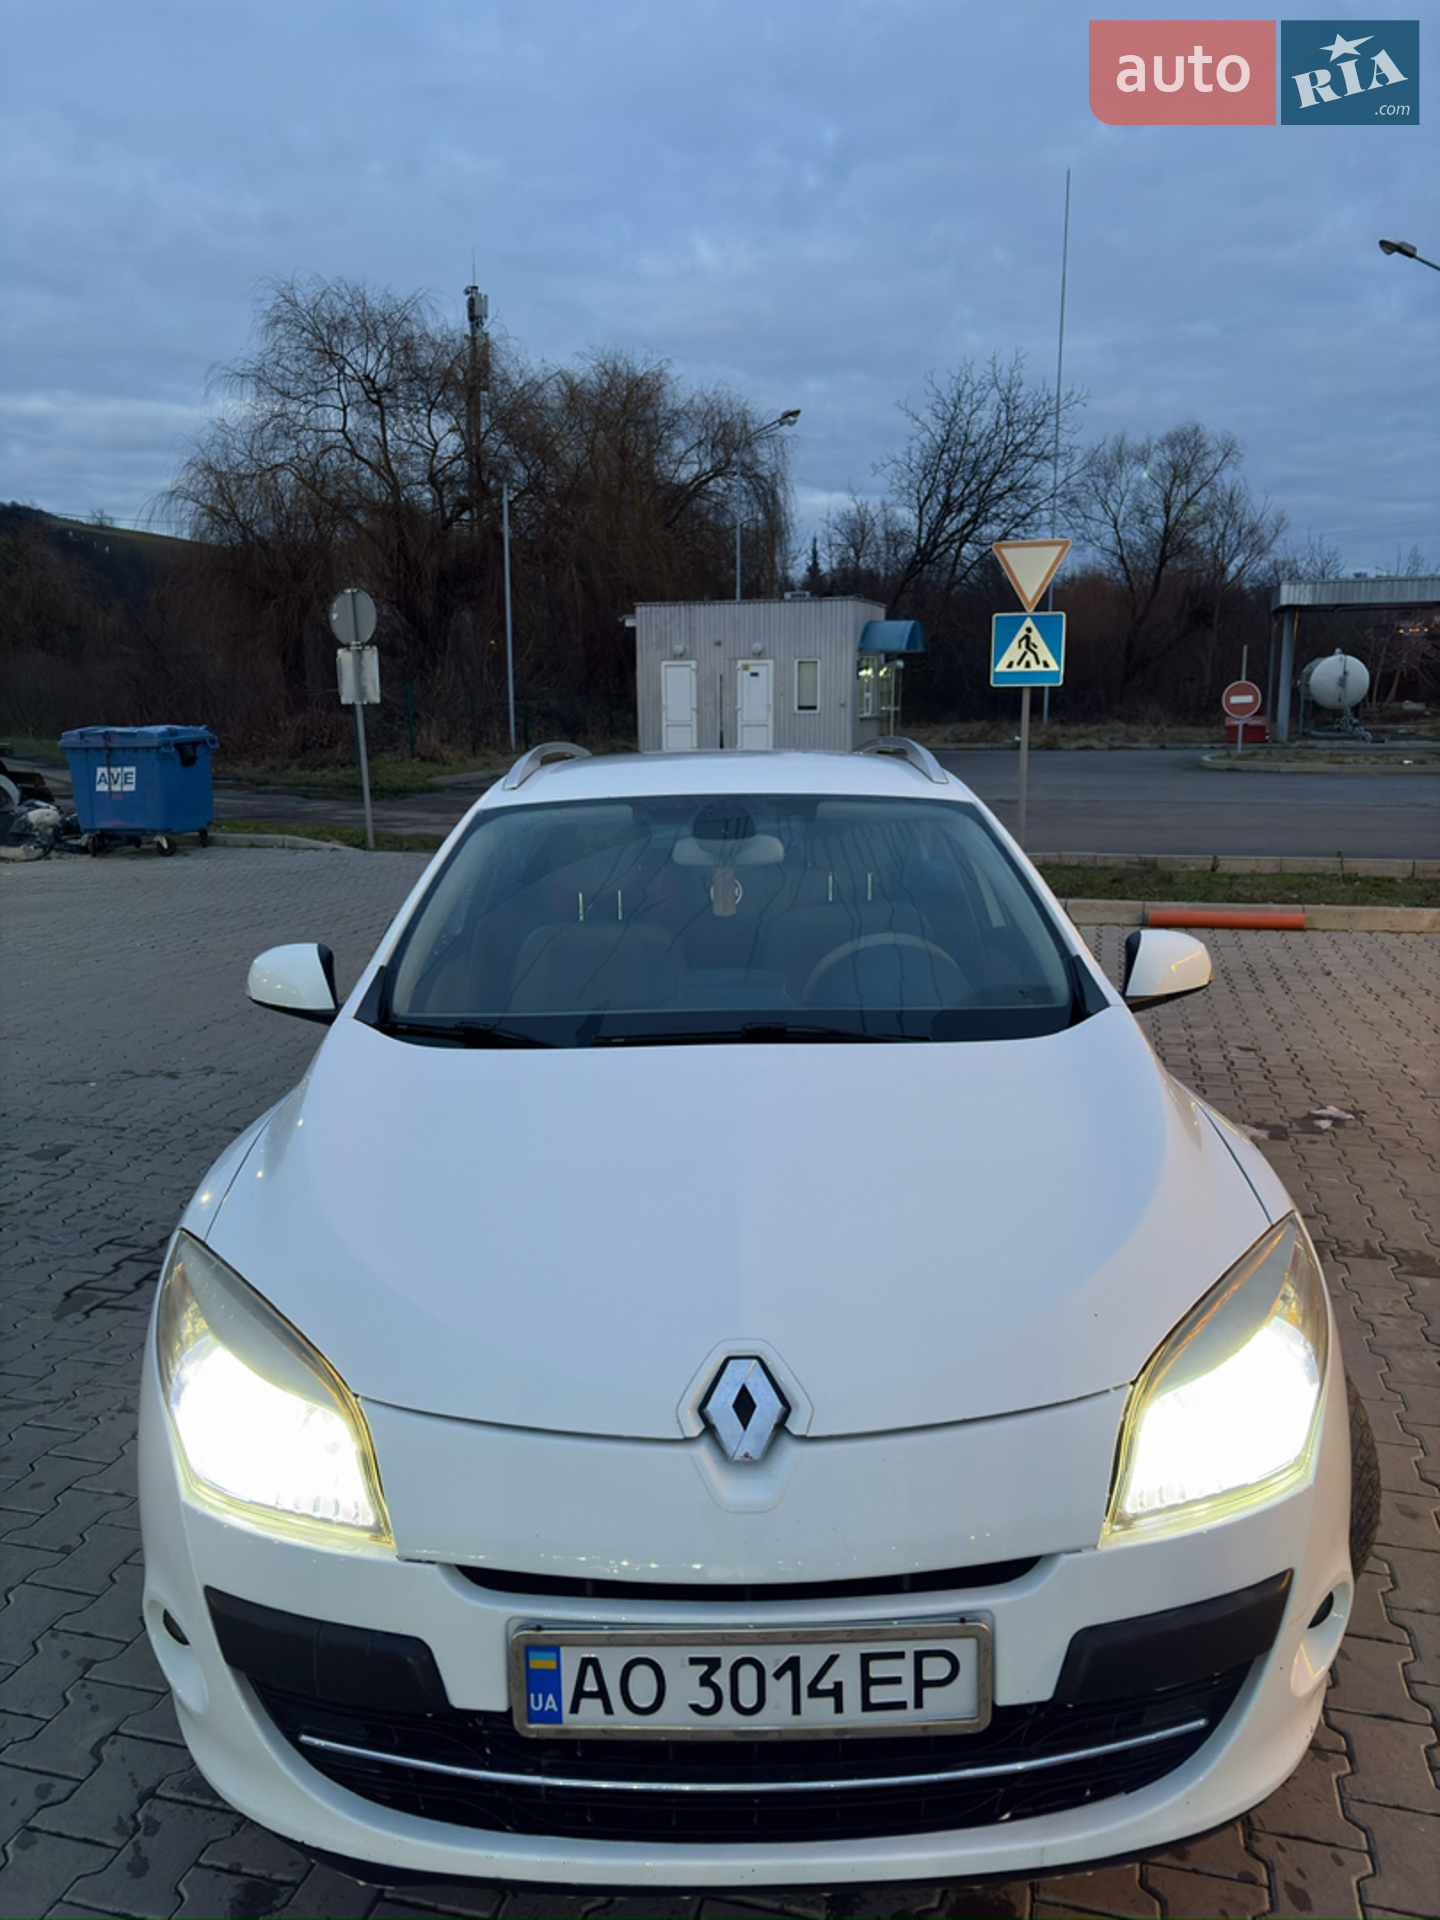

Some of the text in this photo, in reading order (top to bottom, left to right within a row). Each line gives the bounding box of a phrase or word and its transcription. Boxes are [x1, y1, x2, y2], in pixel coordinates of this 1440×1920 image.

[97, 771, 134, 785] AVE
[568, 1649, 962, 1717] AO 3014 EP
[529, 1692, 558, 1713] UA
